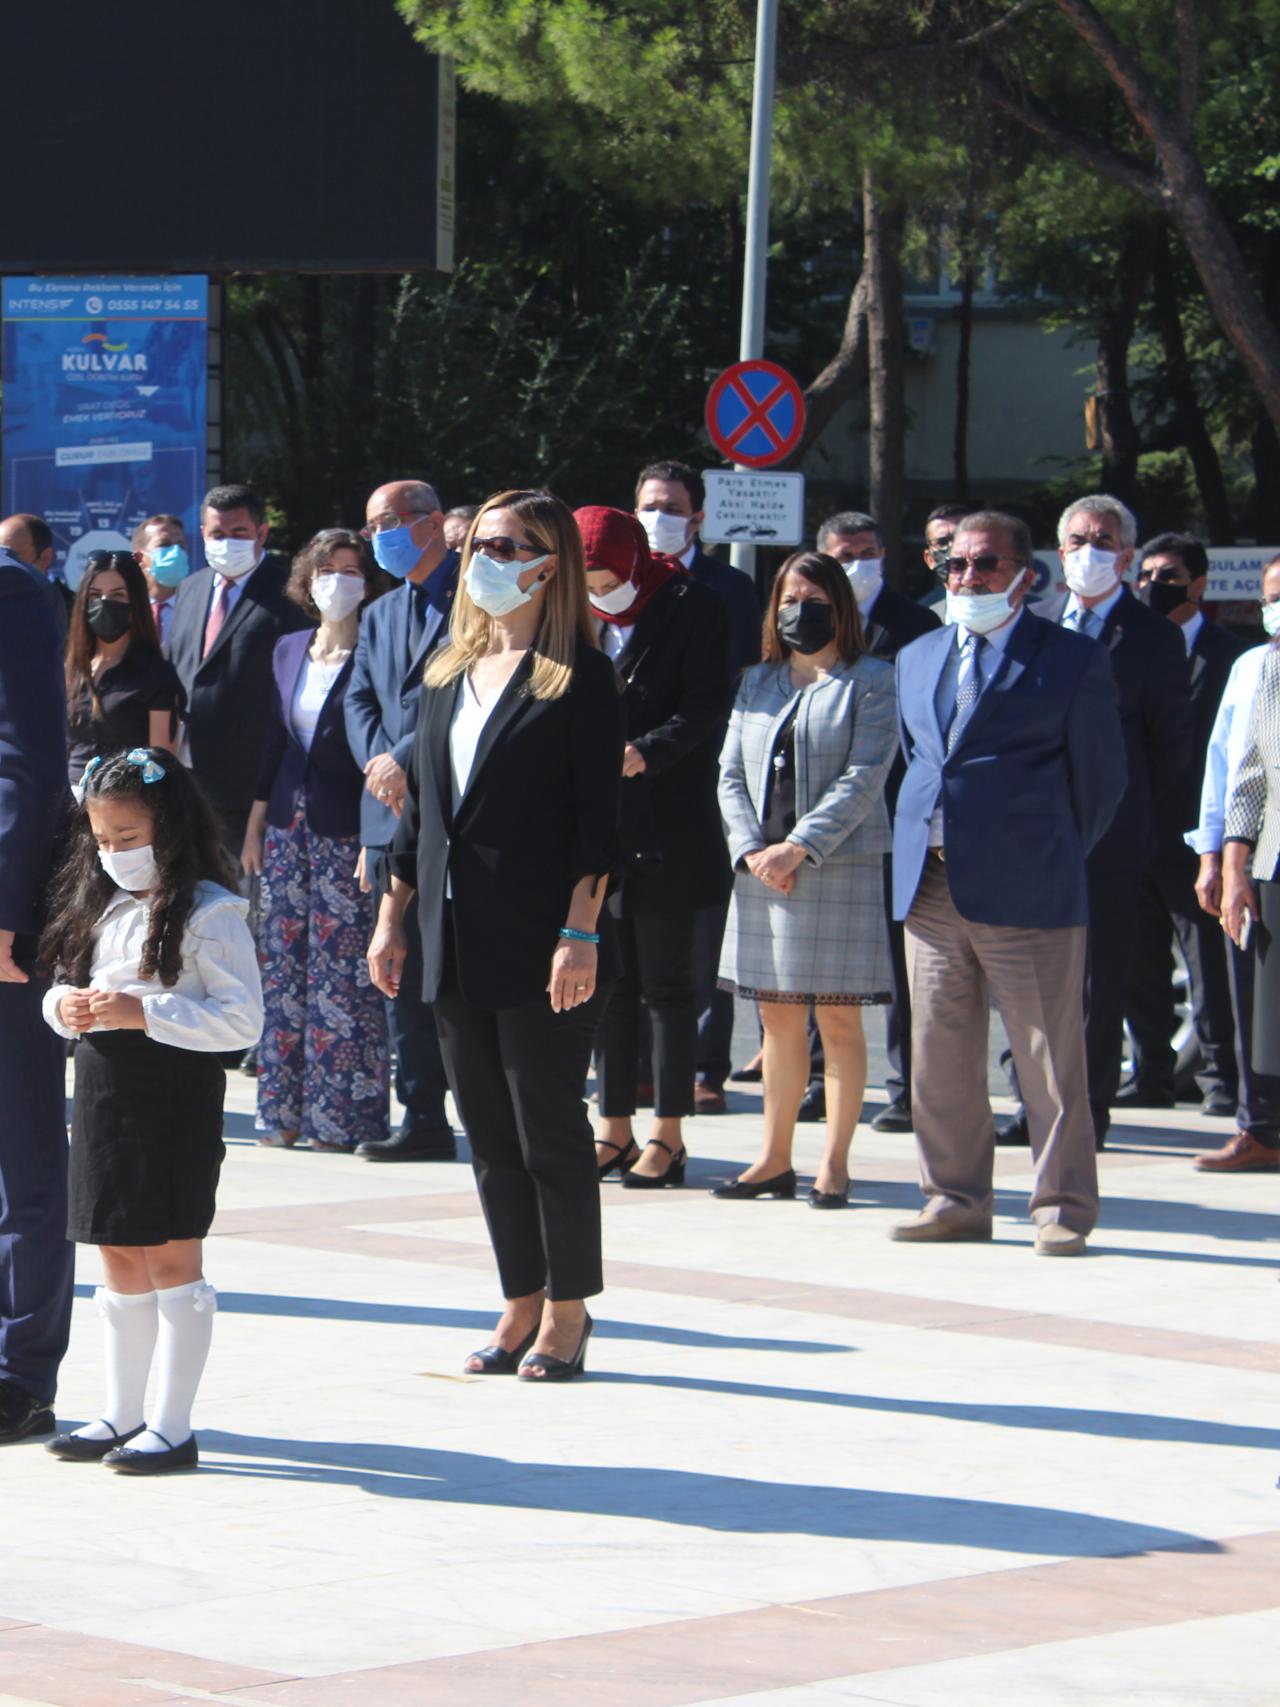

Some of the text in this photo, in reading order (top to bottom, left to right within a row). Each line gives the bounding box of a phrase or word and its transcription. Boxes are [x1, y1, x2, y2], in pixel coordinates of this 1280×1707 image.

[27, 283, 42, 293] Bu
[83, 283, 121, 293] Reklam
[123, 283, 161, 293] Vermek
[107, 299, 138, 311] 0555
[141, 299, 161, 311] 147
[164, 299, 181, 311] 54
[183, 299, 200, 311] 55
[62, 353, 148, 371] KULVAR
[717, 477, 787, 488] Park Etmek
[728, 489, 777, 498] Yasaktır
[720, 499, 785, 510] Aksi Halde
